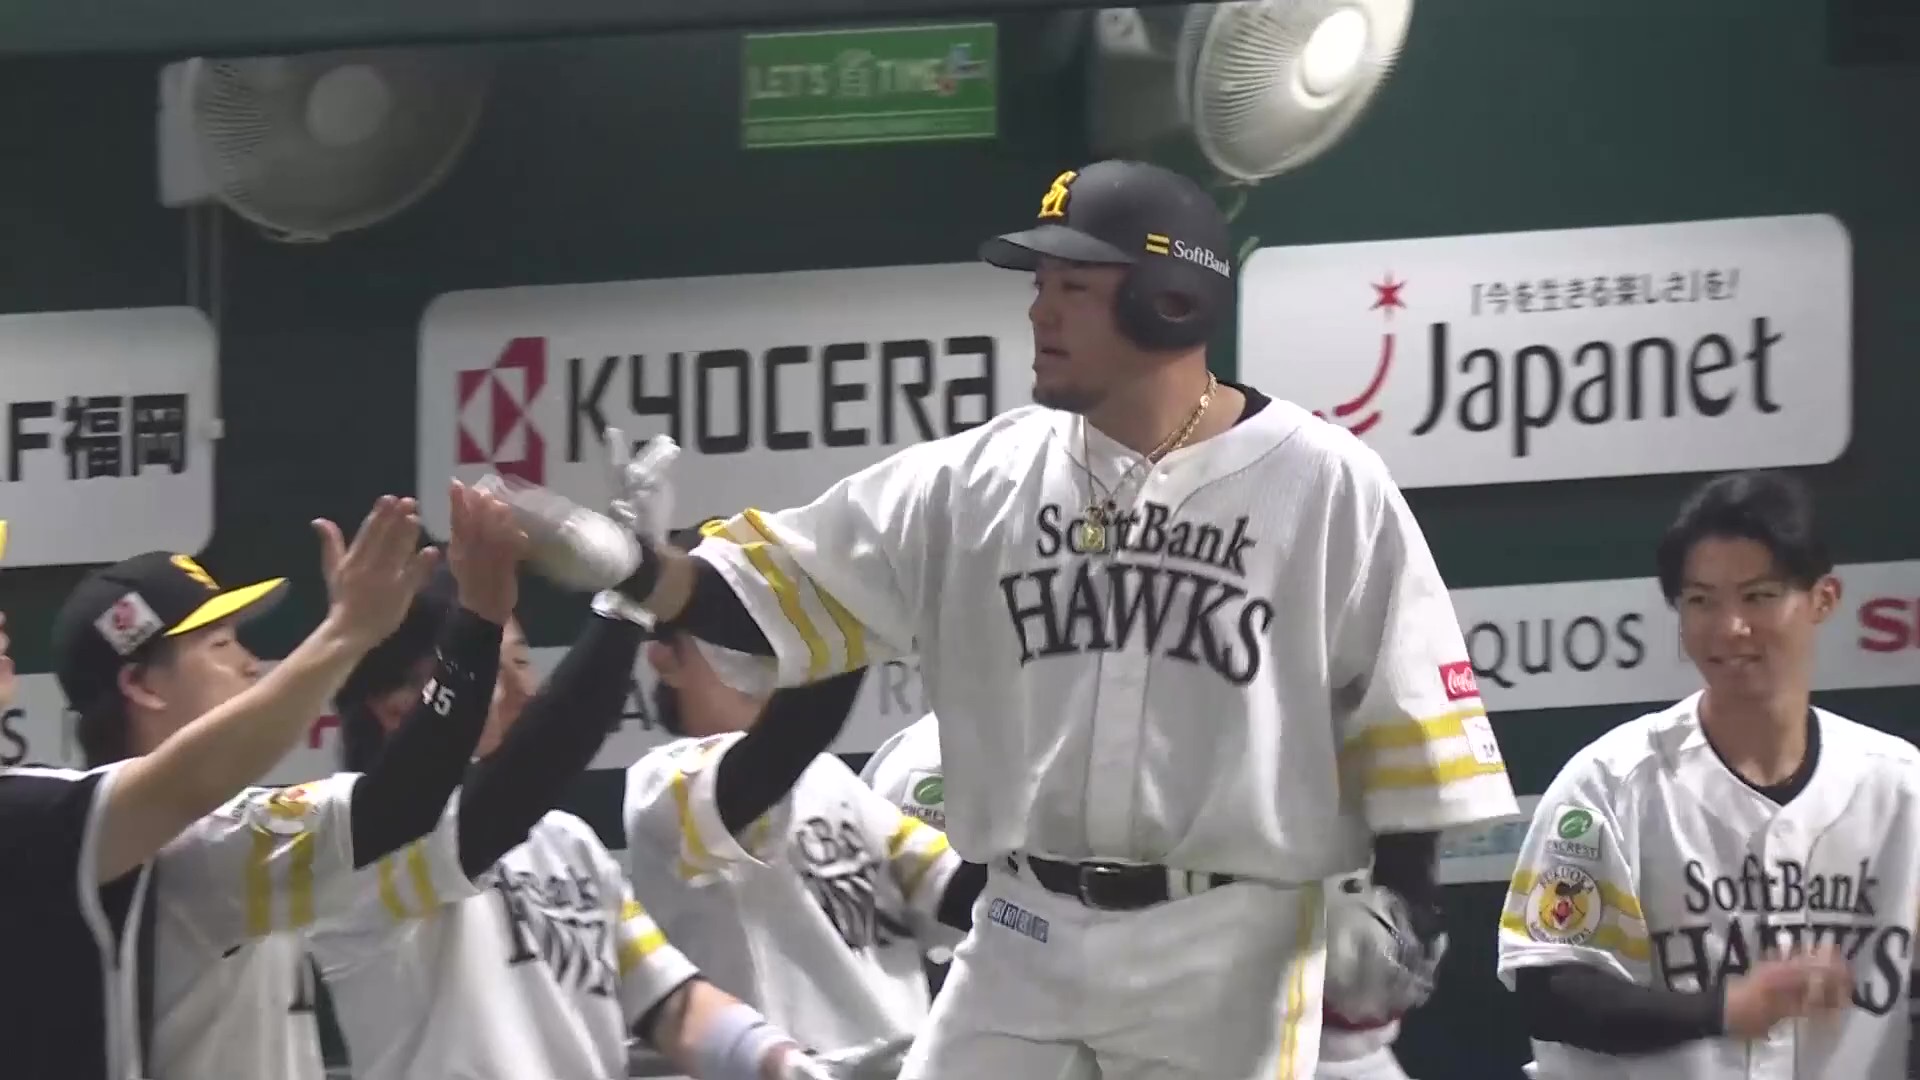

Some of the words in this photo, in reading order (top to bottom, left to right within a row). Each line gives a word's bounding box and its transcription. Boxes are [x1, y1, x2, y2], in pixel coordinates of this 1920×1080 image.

[1173, 240, 1231, 278] SoftBank
[566, 335, 998, 463] KYOCERA
[1410, 316, 1784, 457] Japanet
[1000, 560, 1274, 685] HAWKS
[1858, 597, 1920, 652] S
[422, 677, 456, 715] 45
[1684, 853, 1879, 915] SoftBank
